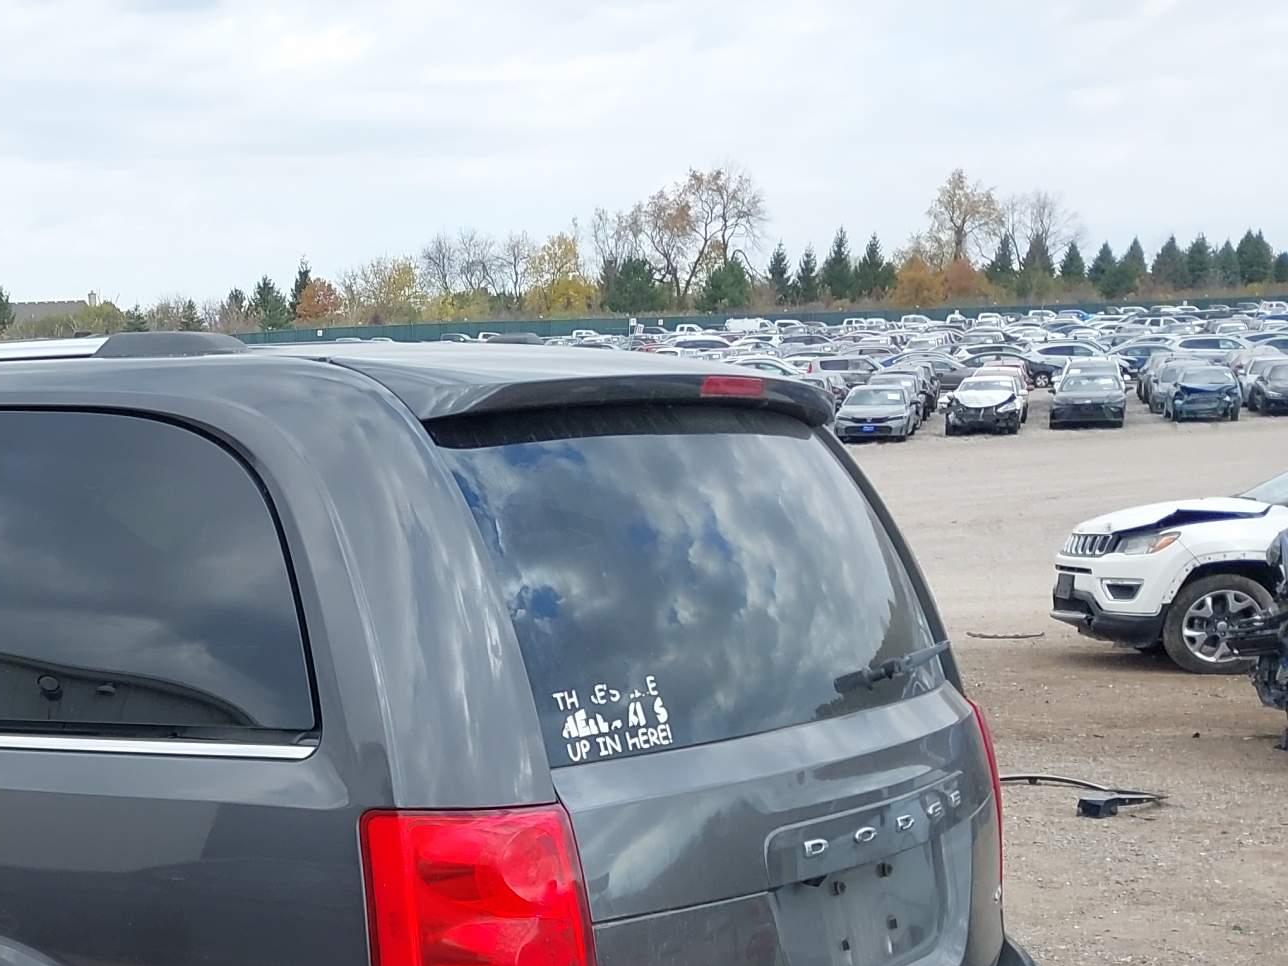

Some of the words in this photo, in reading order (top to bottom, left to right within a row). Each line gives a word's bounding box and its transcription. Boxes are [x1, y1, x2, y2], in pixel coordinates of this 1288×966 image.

[567, 740, 590, 762] UP
[596, 734, 622, 756] IN
[804, 790, 961, 857] DODGE
